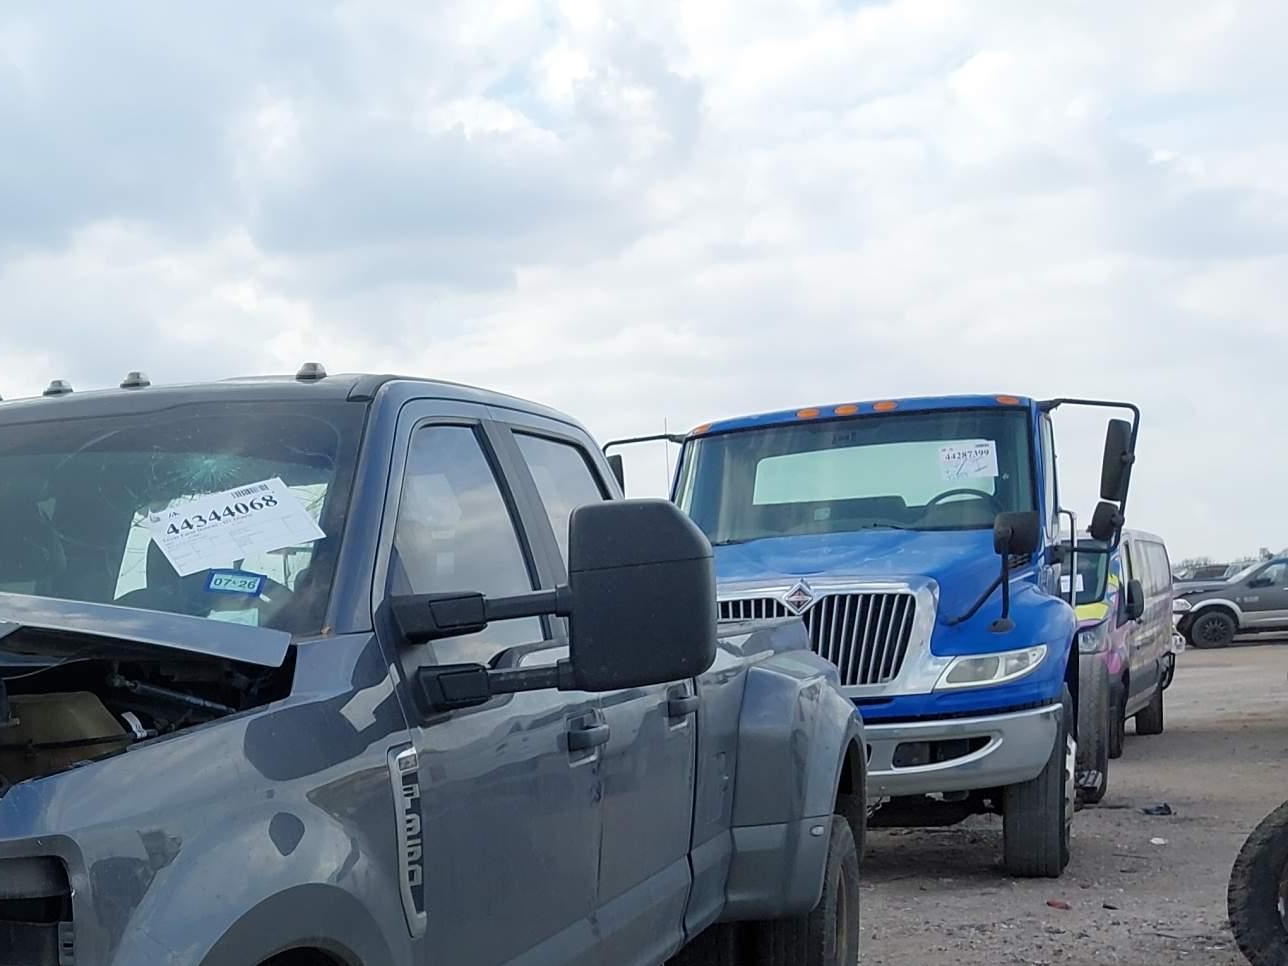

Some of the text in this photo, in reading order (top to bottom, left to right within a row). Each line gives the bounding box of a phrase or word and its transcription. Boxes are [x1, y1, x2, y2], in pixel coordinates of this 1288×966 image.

[166, 494, 278, 536] 44344068
[212, 577, 257, 590] 07 26
